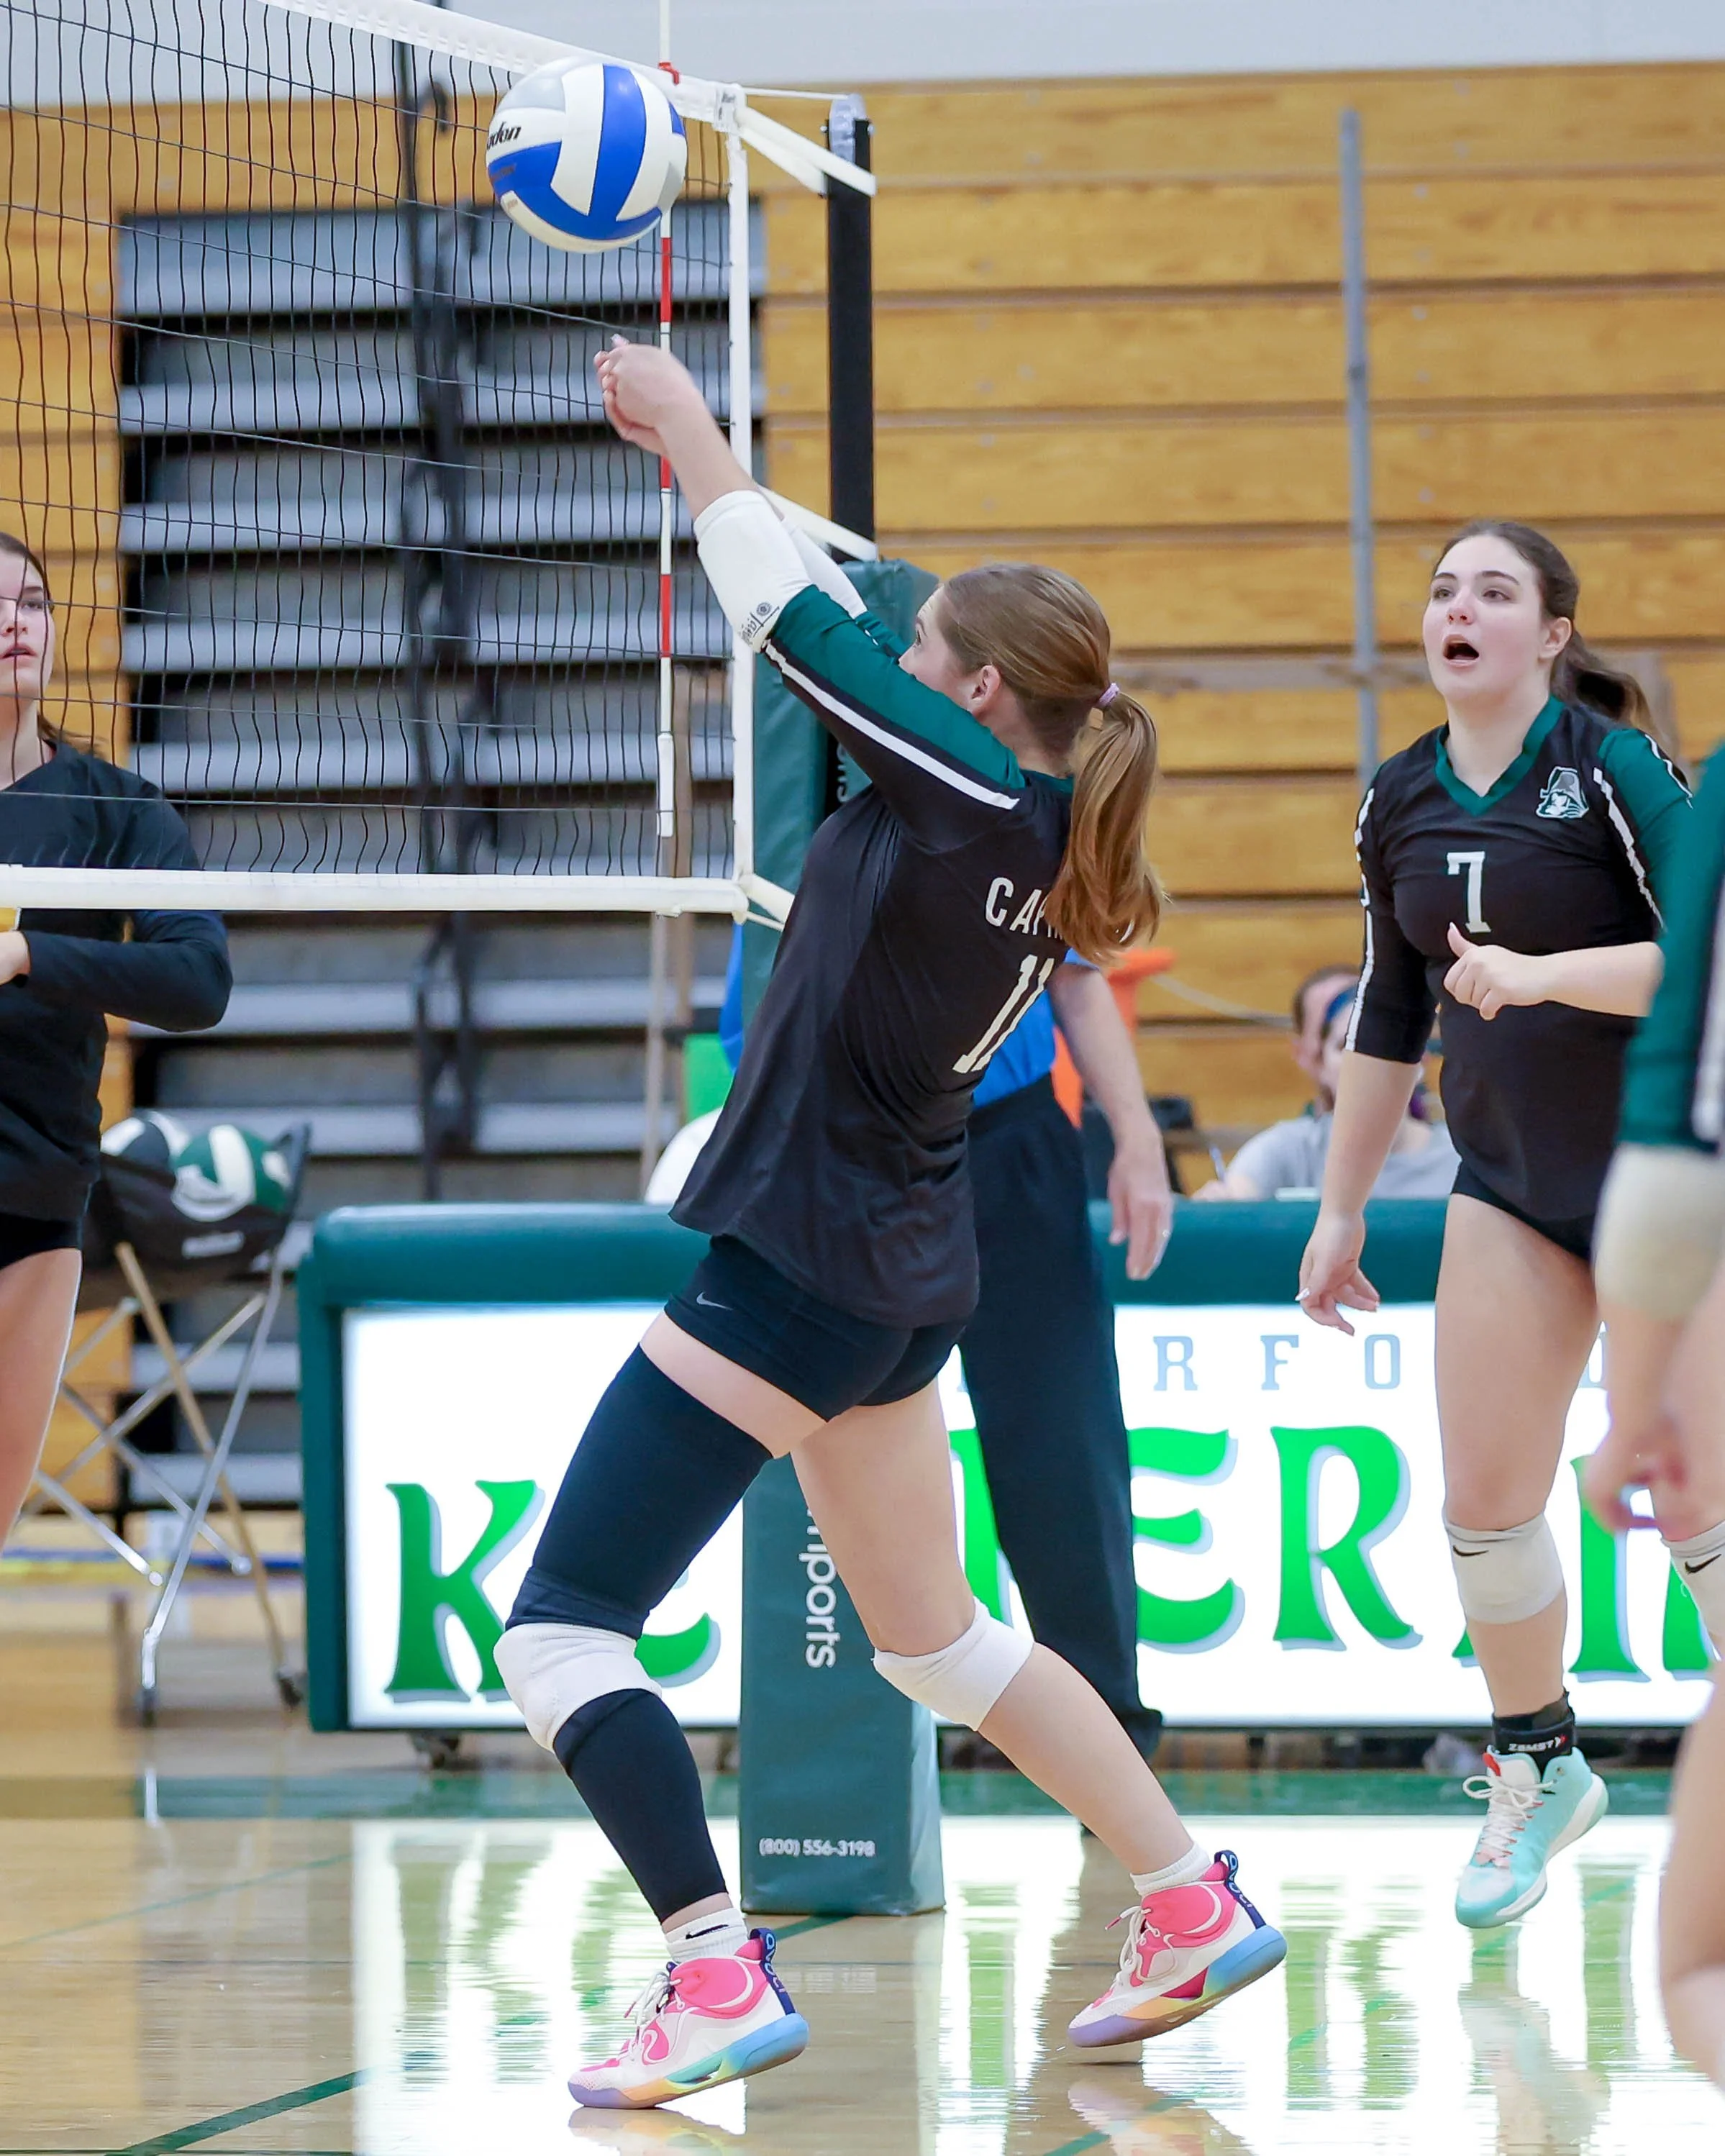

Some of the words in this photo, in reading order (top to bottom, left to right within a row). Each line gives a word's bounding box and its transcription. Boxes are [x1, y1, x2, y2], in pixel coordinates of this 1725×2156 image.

[1447, 851, 1491, 933] 7
[952, 954, 1055, 1074] 11
[759, 1837, 801, 1857] (800)
[802, 1839, 875, 1857] 556-3198
